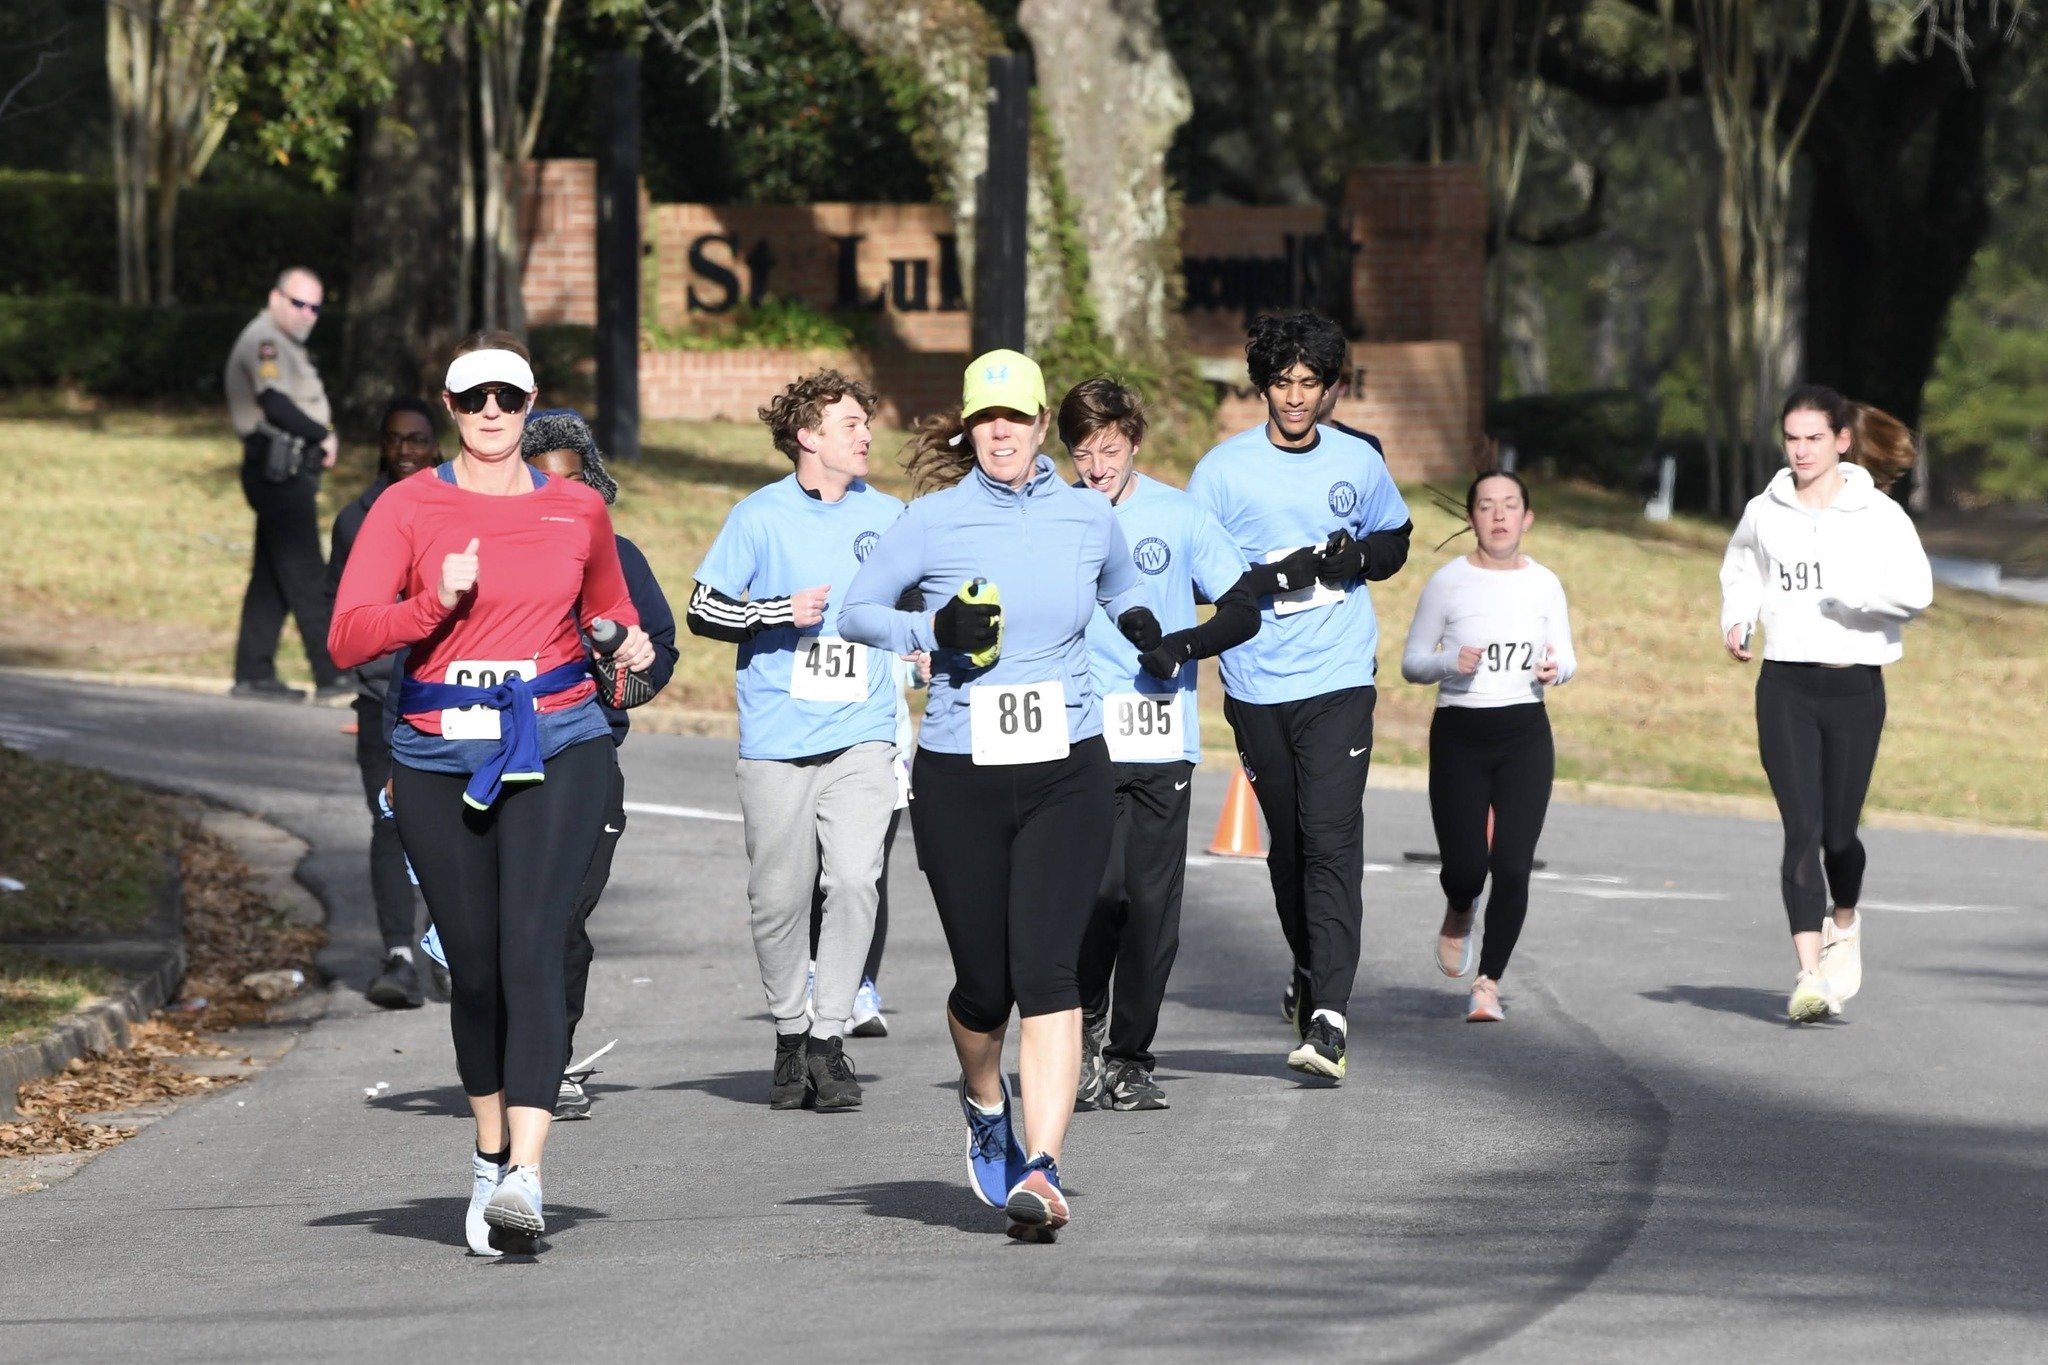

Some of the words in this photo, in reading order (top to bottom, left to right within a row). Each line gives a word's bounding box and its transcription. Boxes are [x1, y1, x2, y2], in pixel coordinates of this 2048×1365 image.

[687, 233, 775, 313] St
[1140, 547, 1163, 574] JW
[1779, 561, 1823, 592] 591
[804, 642, 857, 678] 451
[1487, 641, 1534, 673] 972
[998, 690, 1042, 735] 86
[1119, 699, 1171, 738] 995
